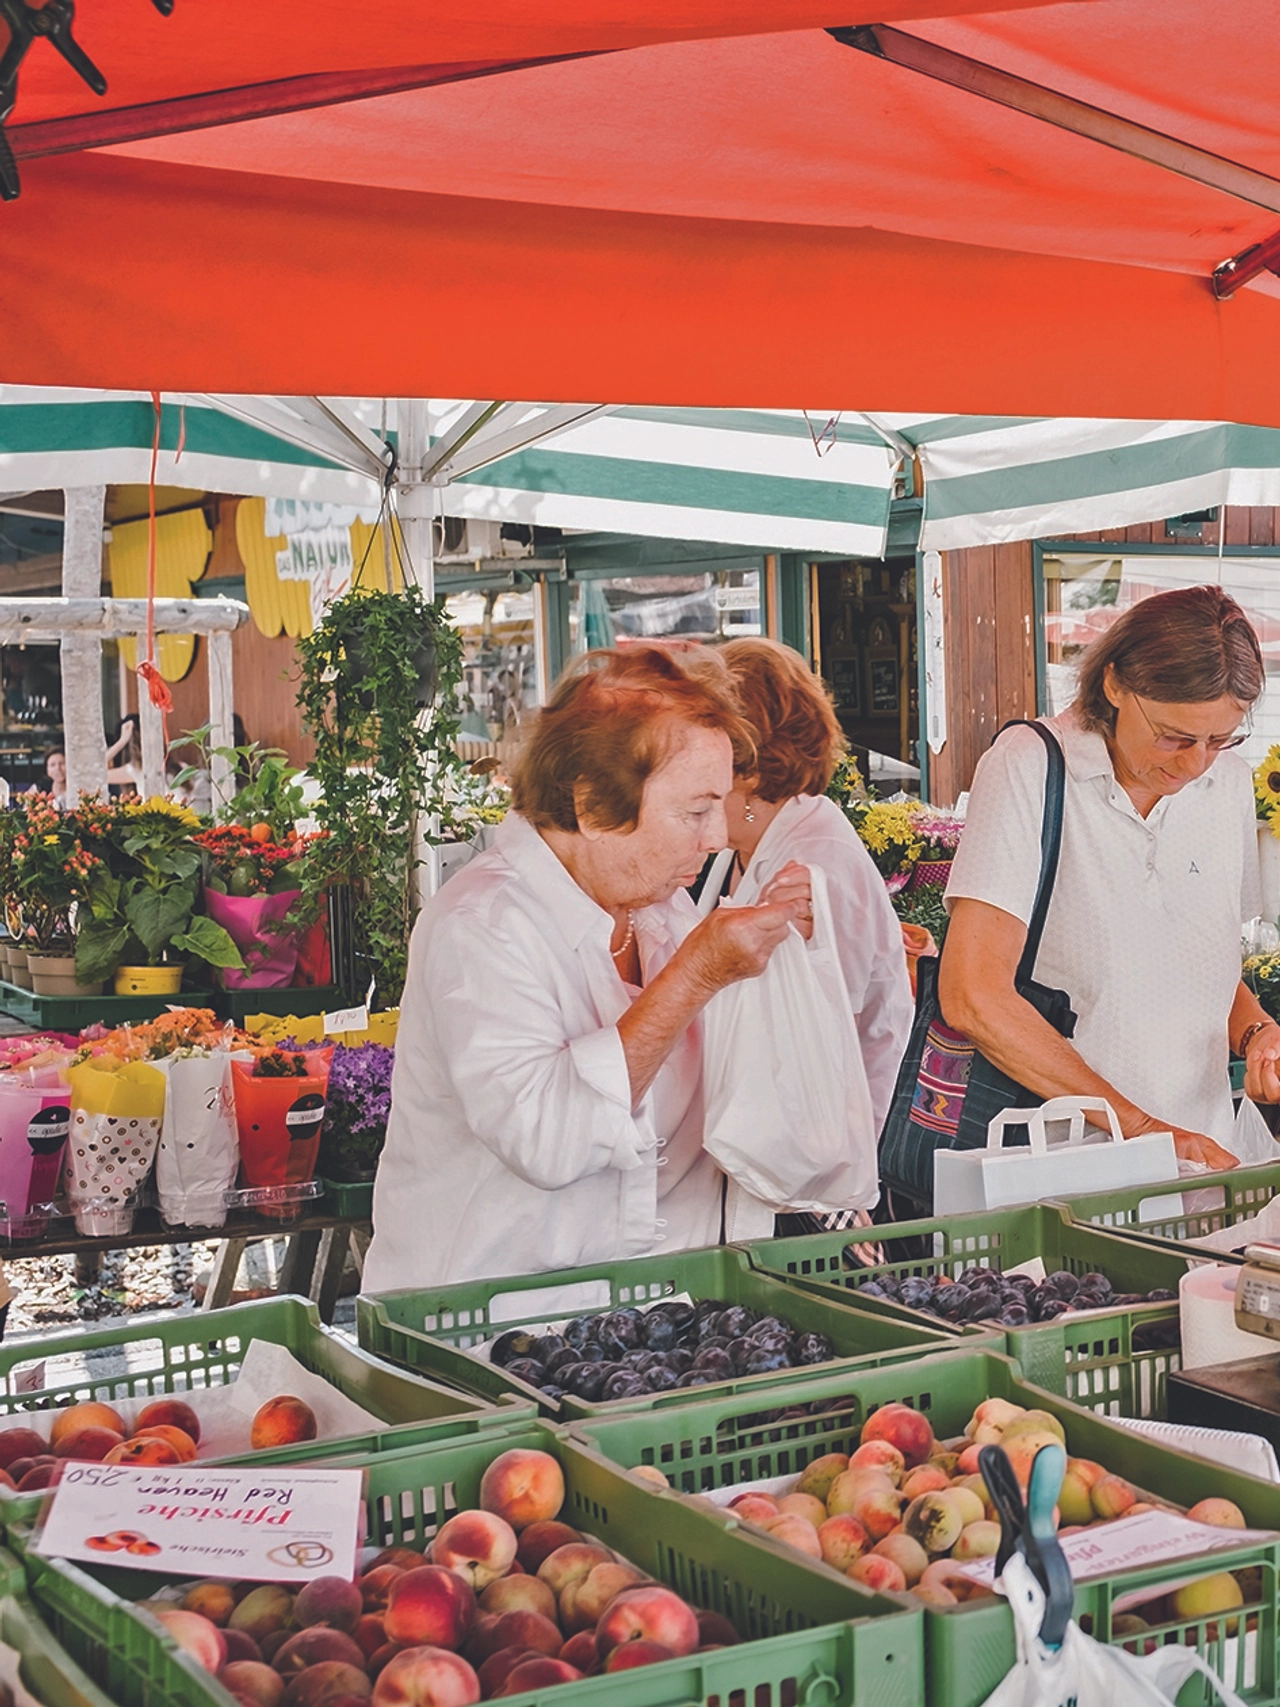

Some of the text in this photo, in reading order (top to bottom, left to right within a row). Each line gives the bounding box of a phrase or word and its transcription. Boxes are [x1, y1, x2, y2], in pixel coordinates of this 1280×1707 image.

[67, 1466, 129, 1487] 2,50
[138, 1487, 293, 1505] Red Heaven
[138, 1504, 292, 1525] Pfirsiche
[169, 1543, 249, 1558] Steirische
